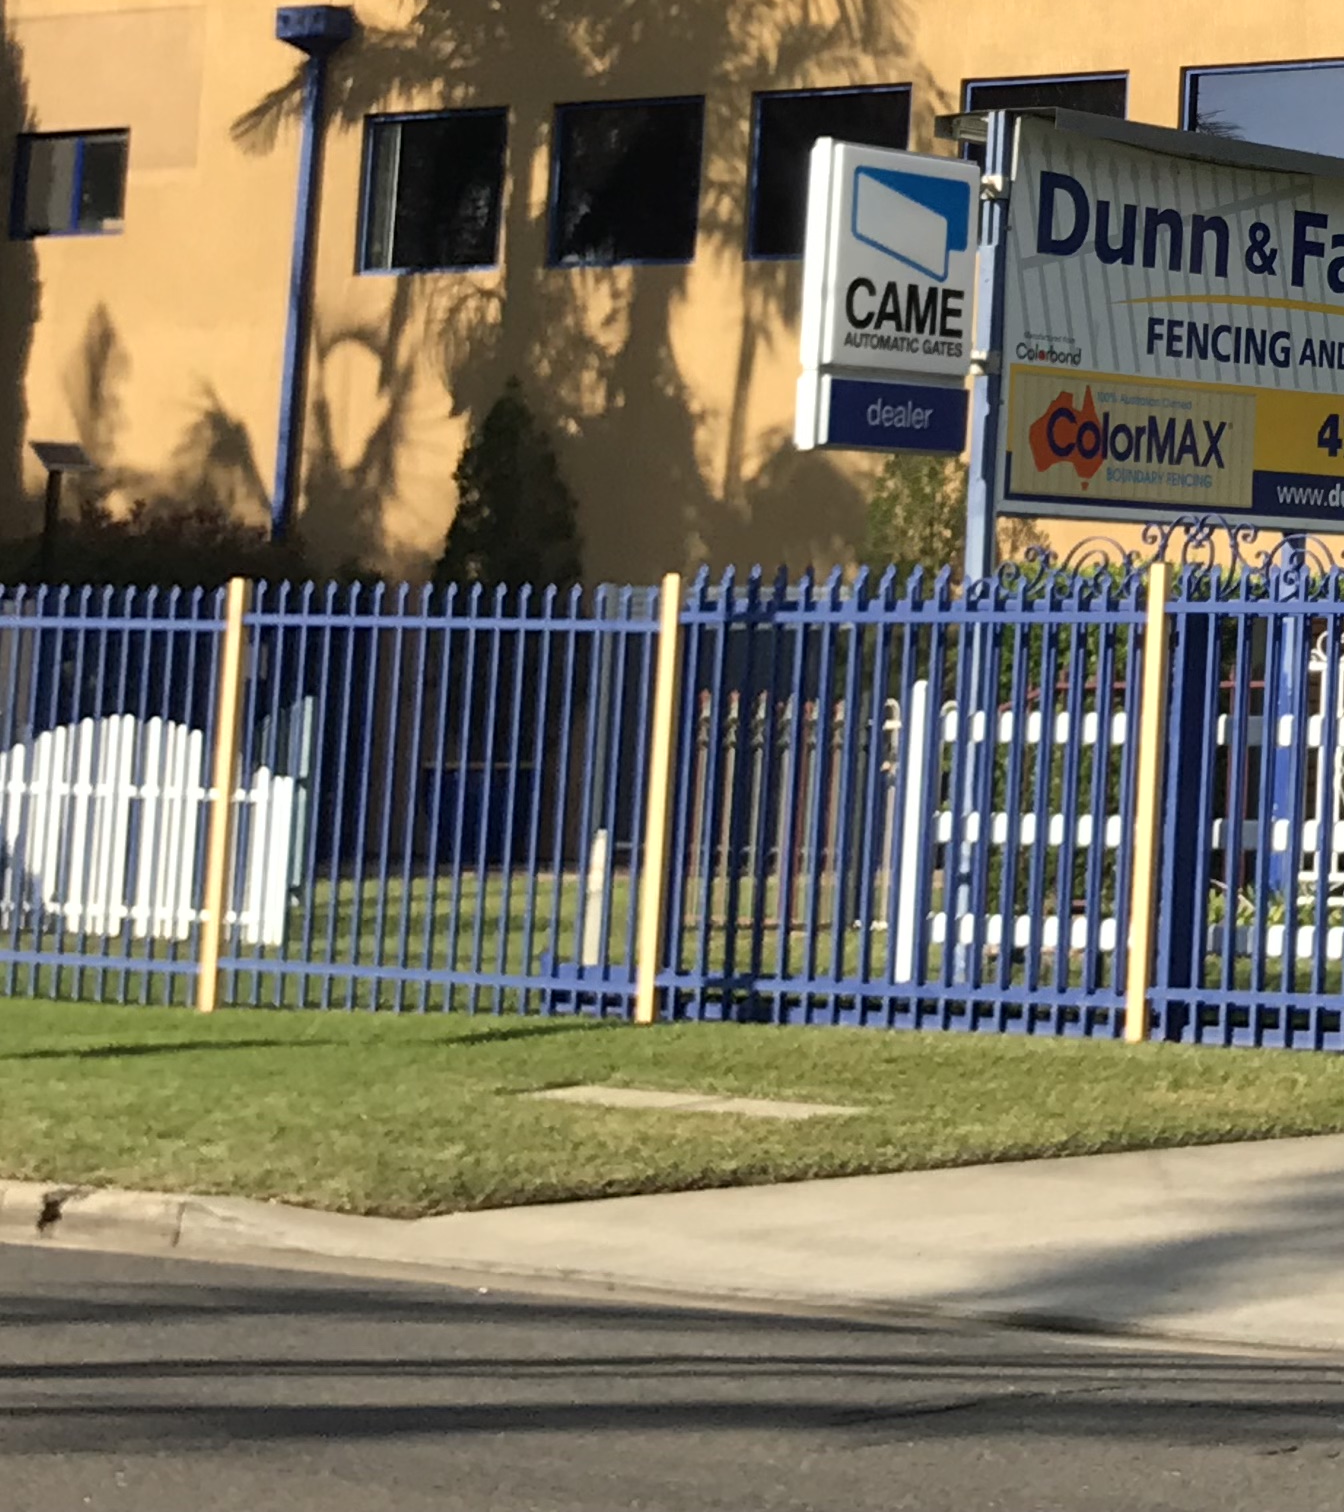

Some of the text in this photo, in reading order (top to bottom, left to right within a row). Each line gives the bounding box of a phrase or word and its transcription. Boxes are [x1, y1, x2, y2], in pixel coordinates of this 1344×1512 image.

[1036, 170, 1229, 279] Dunn
[1245, 221, 1279, 277] &
[845, 276, 965, 339] CAME
[843, 332, 963, 358] AUTOMATIC GATES
[1016, 341, 1082, 365] Colorbond
[1146, 317, 1291, 369] FENCING
[866, 397, 933, 429] dealer
[1046, 407, 1228, 469] ColorMAX
[1106, 467, 1212, 488] BOUNDARY FENCING
